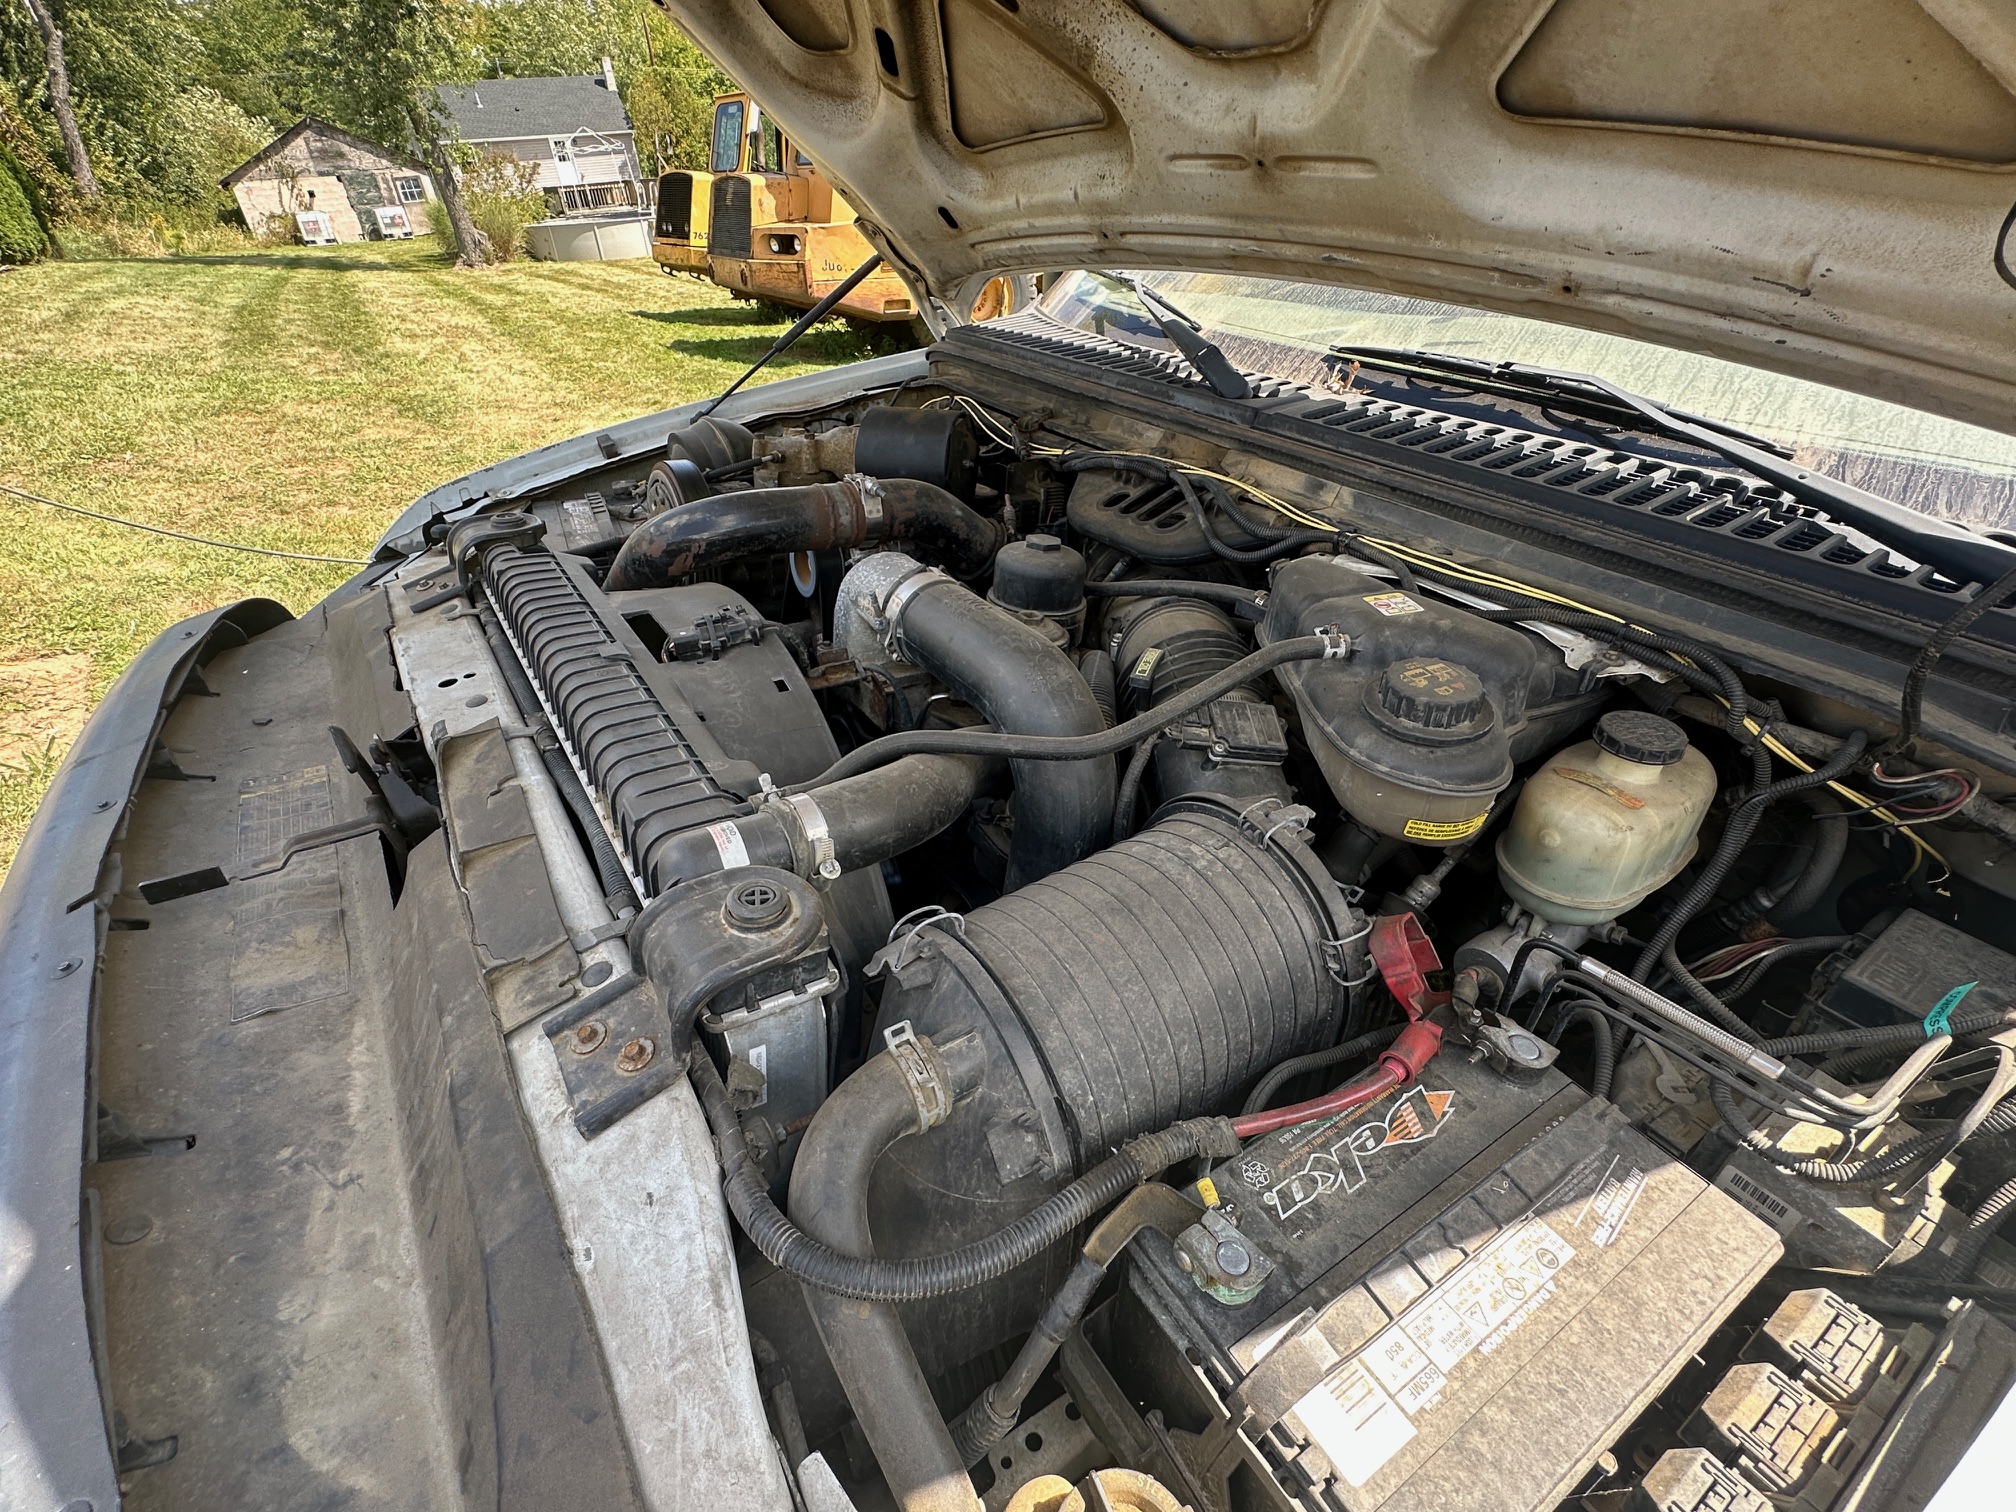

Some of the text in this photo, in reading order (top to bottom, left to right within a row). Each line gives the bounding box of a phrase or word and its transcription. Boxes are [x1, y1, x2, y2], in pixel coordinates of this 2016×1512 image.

[1270, 1083, 1455, 1220] Deka
[1382, 1339, 1405, 1362] 850
[1403, 1365, 1441, 1401] 665MF
